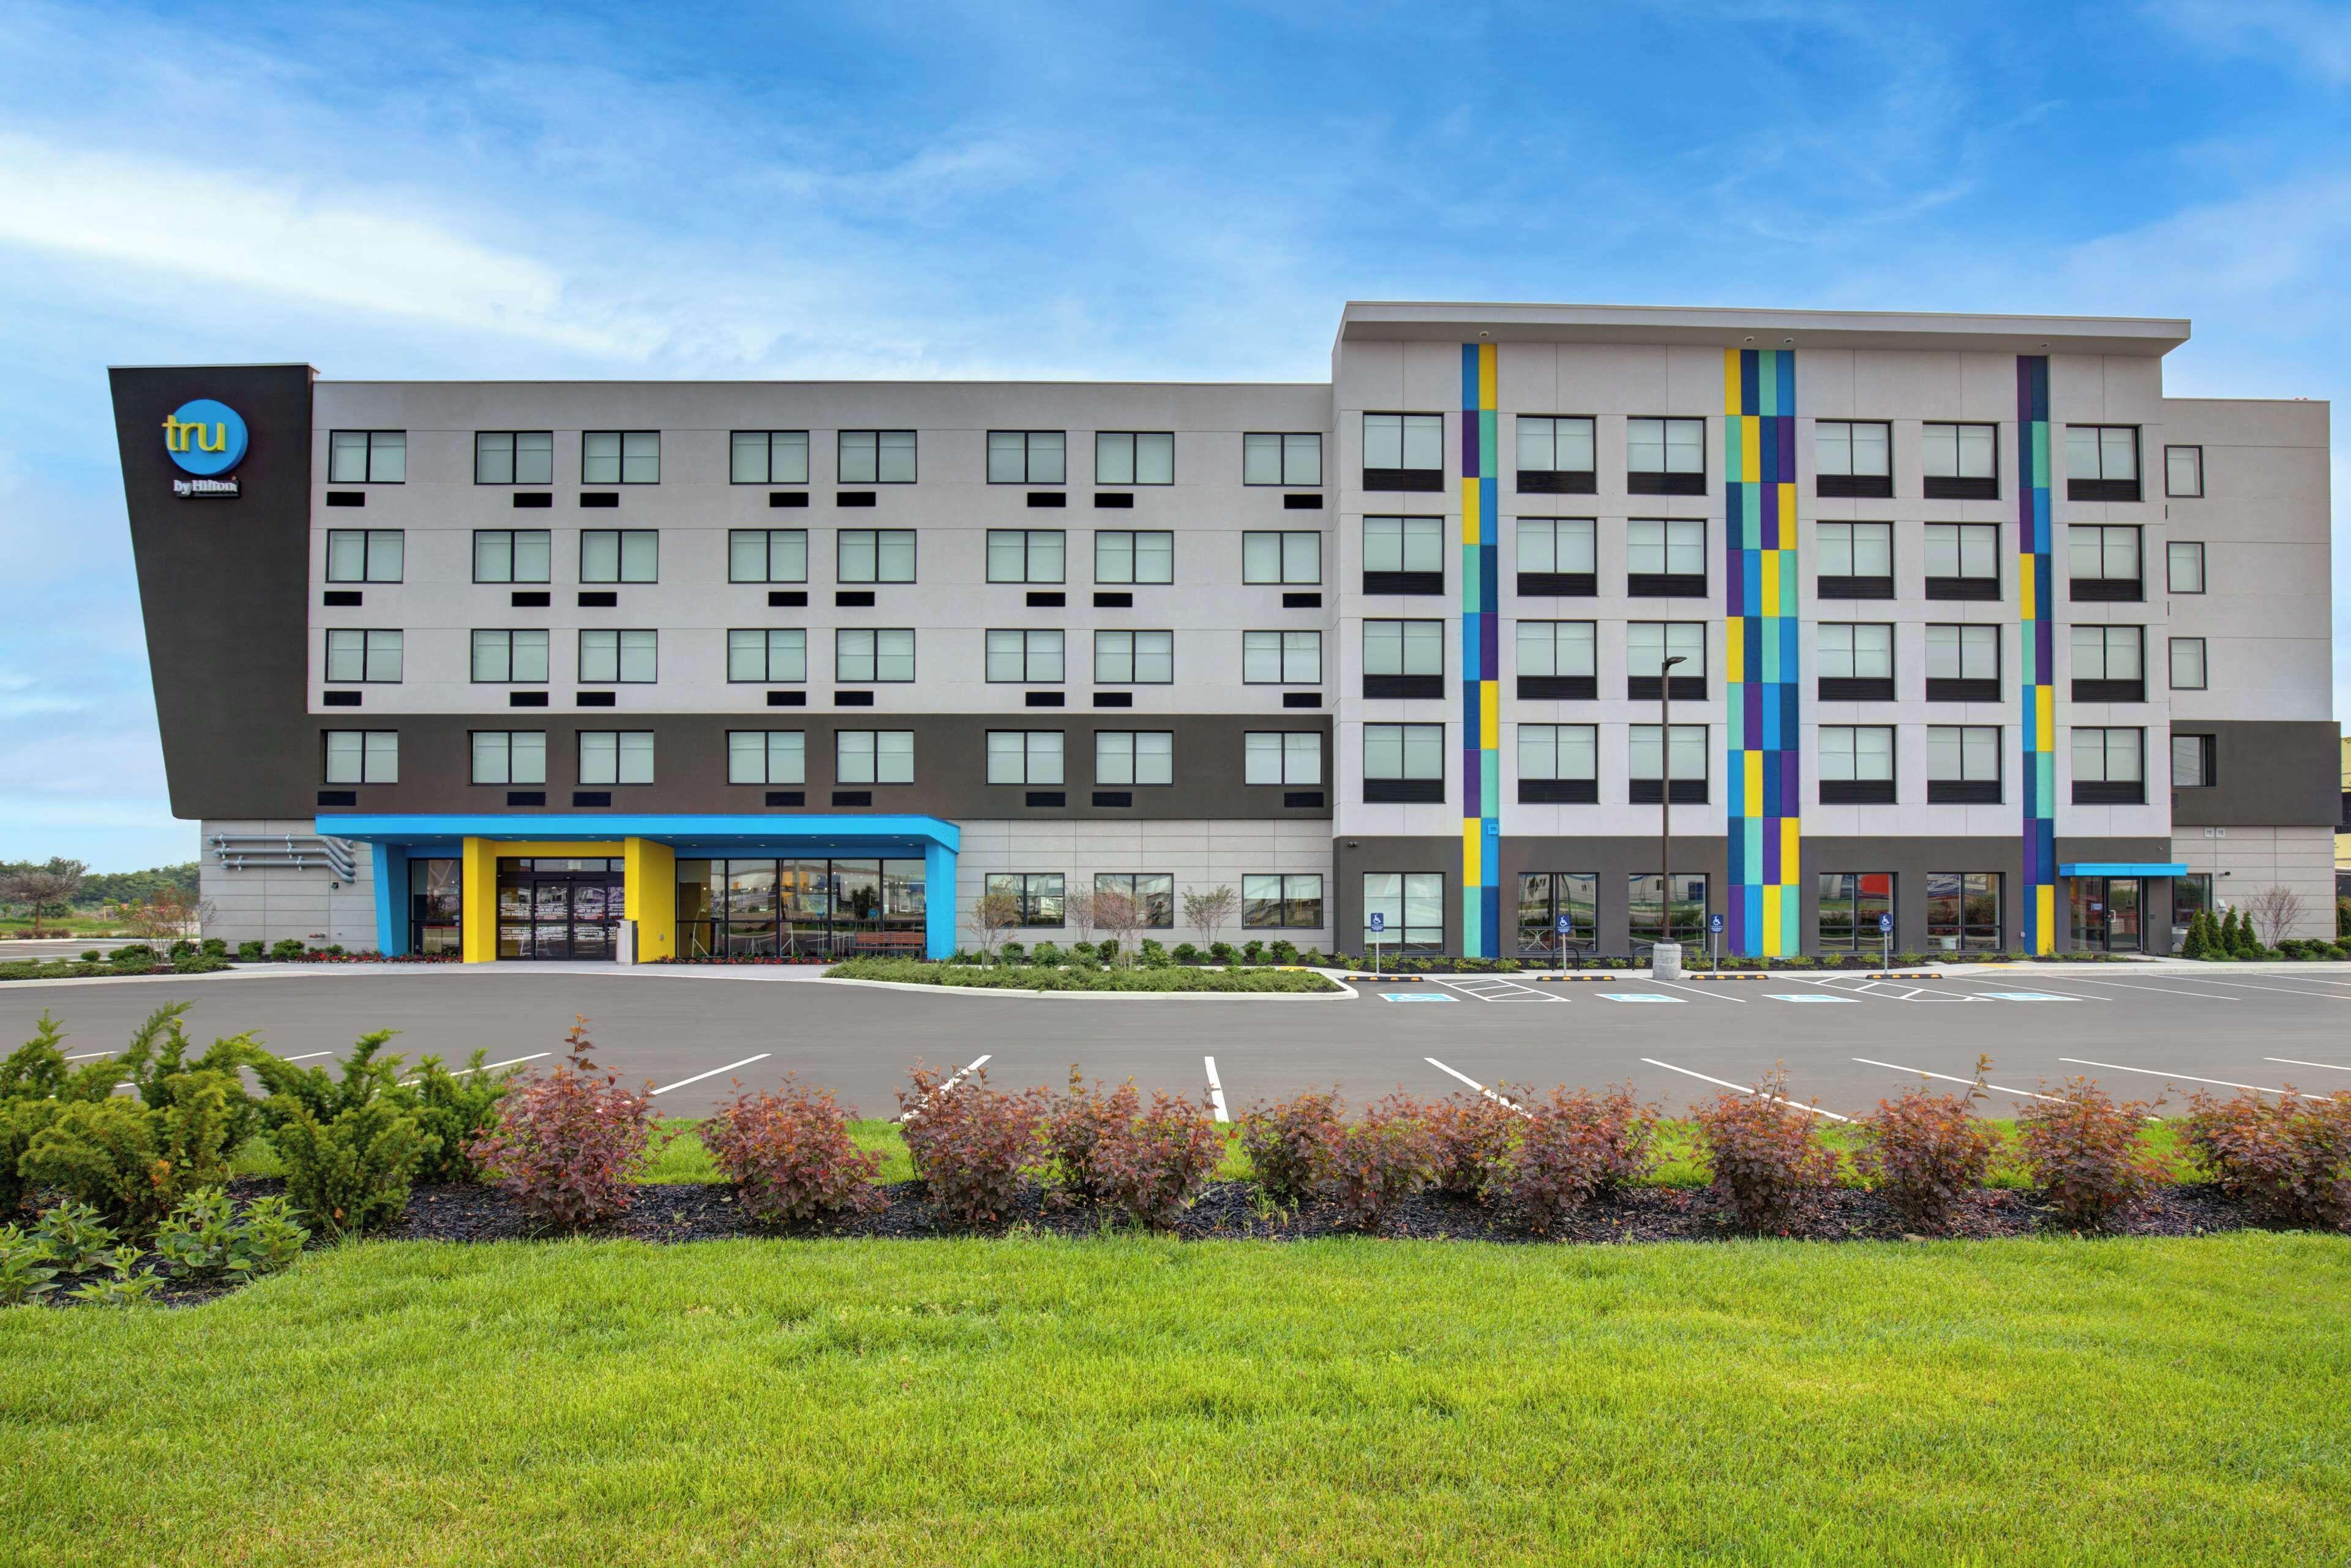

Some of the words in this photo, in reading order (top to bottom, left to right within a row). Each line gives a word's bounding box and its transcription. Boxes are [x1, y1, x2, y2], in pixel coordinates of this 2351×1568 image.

[162, 415, 226, 452] tru
[173, 479, 191, 495] by
[192, 479, 238, 492] Hilton
